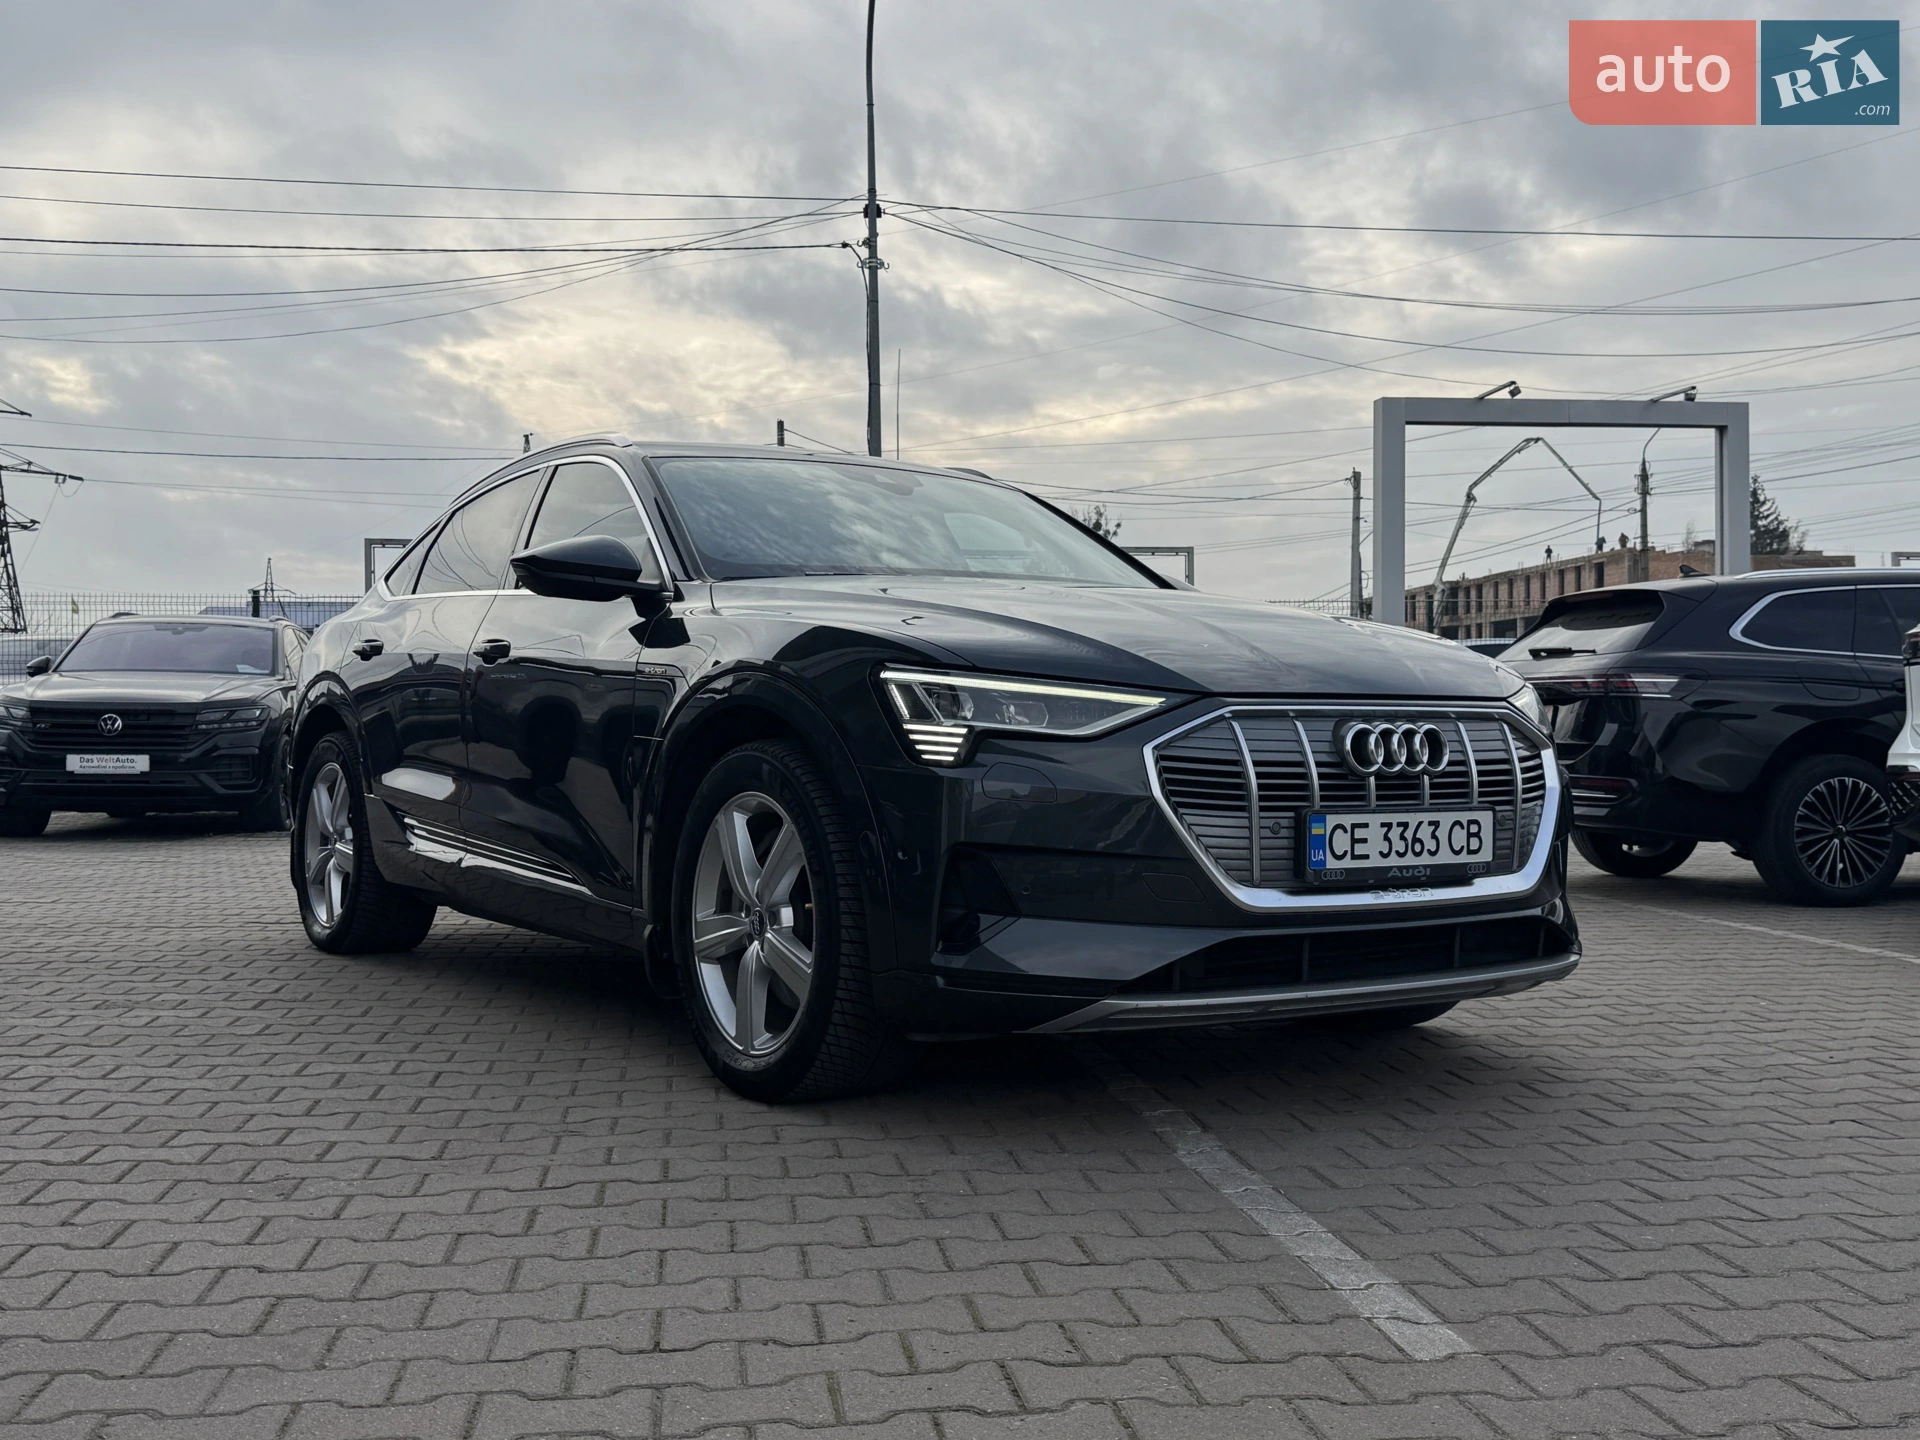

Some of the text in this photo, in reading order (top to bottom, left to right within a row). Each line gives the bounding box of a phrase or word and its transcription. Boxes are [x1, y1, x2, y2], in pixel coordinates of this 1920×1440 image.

[79, 756, 138, 764] Das WeltAuto.
[1328, 819, 1483, 861] CE 3363 CB
[1311, 849, 1325, 862] UA
[1387, 866, 1431, 878] Audi
